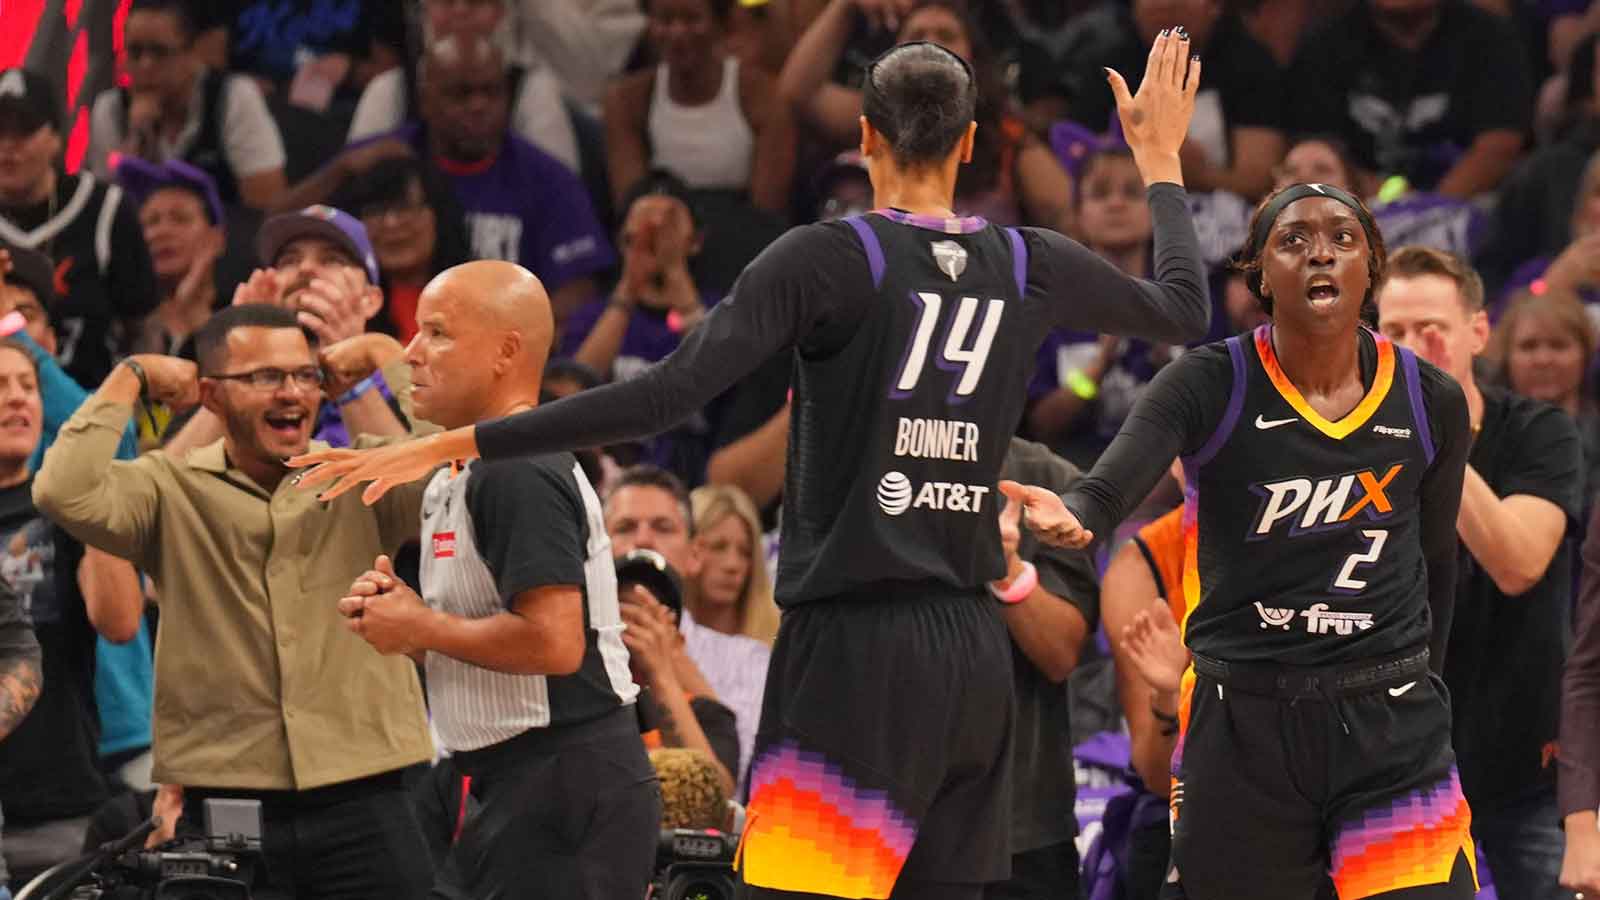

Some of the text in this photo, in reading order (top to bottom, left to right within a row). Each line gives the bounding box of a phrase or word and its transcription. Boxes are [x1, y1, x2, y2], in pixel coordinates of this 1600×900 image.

[895, 292, 1005, 397] 14
[895, 416, 980, 463] BONNER
[913, 483, 989, 513] AT&T
[1256, 464, 1403, 535] PHX
[1334, 529, 1388, 590] 2
